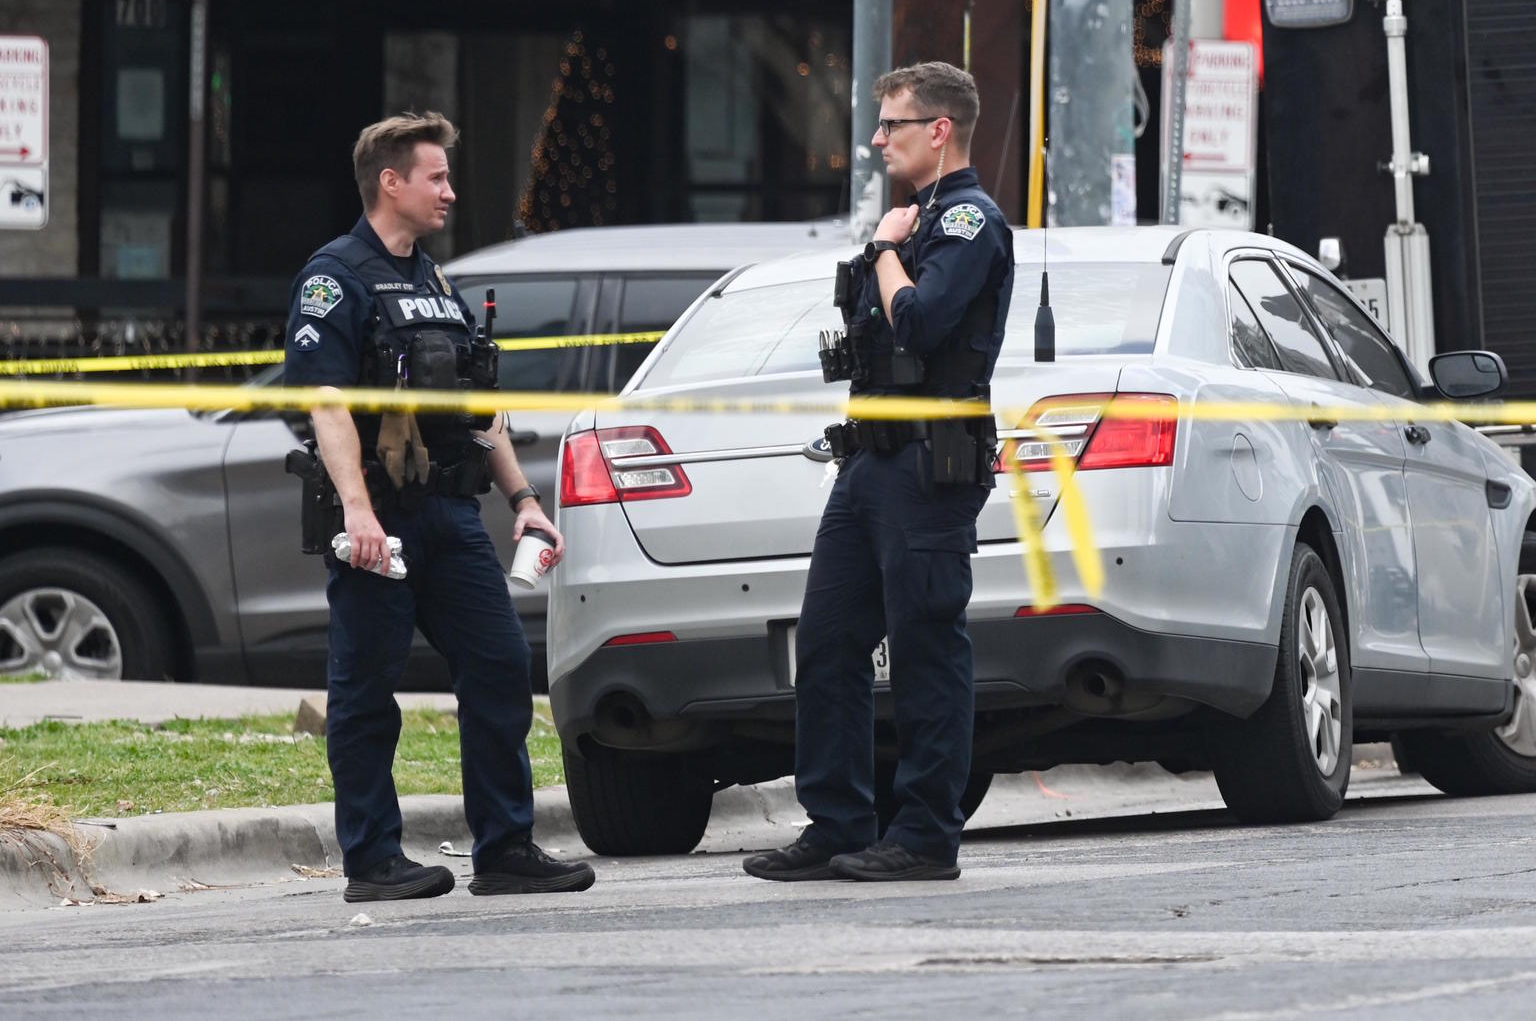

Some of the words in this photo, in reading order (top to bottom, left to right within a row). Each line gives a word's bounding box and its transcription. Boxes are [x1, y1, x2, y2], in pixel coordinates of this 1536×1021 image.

[0, 48, 39, 65] ARKING
[306, 277, 341, 297] POLICE
[303, 304, 326, 315] AUSTIN
[398, 297, 466, 322] POLIC
